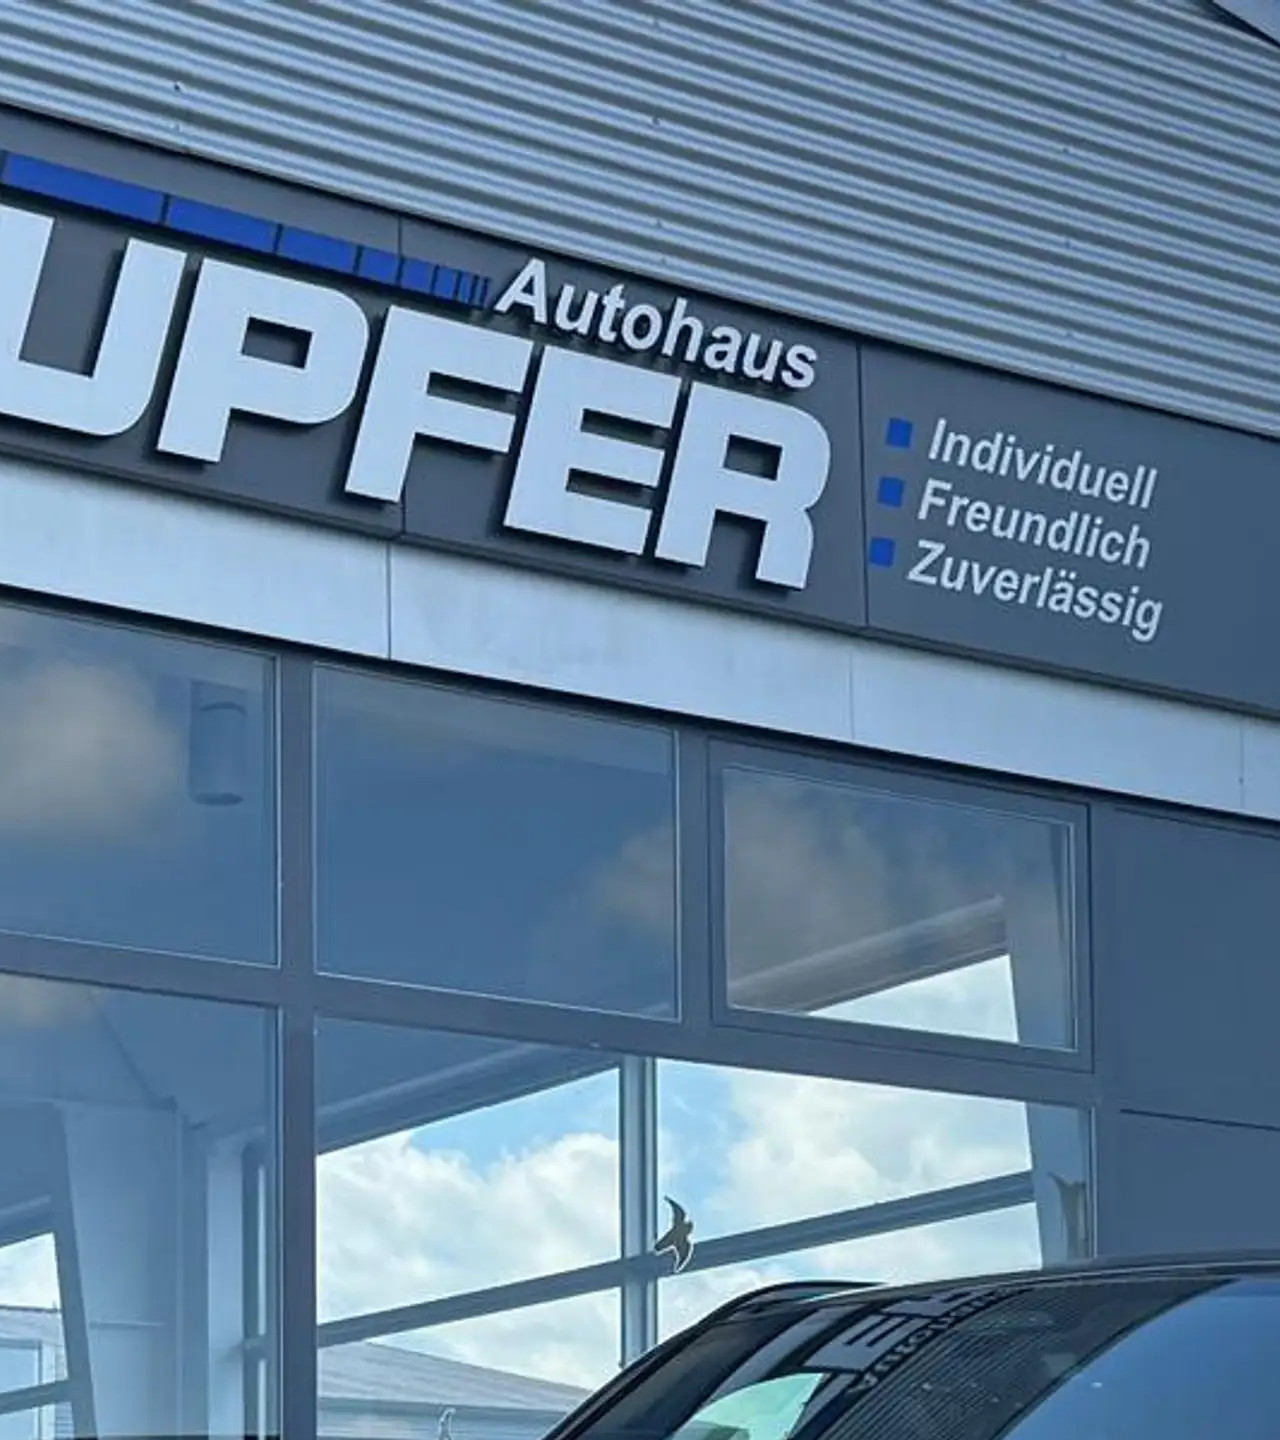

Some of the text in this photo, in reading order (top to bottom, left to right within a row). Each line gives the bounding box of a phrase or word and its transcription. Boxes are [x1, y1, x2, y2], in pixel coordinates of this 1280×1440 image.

[493, 256, 820, 392] Autohaus
[928, 417, 1158, 509] Individuell
[918, 478, 1152, 569] Freundlich
[905, 538, 1165, 643] Zuverlässig
